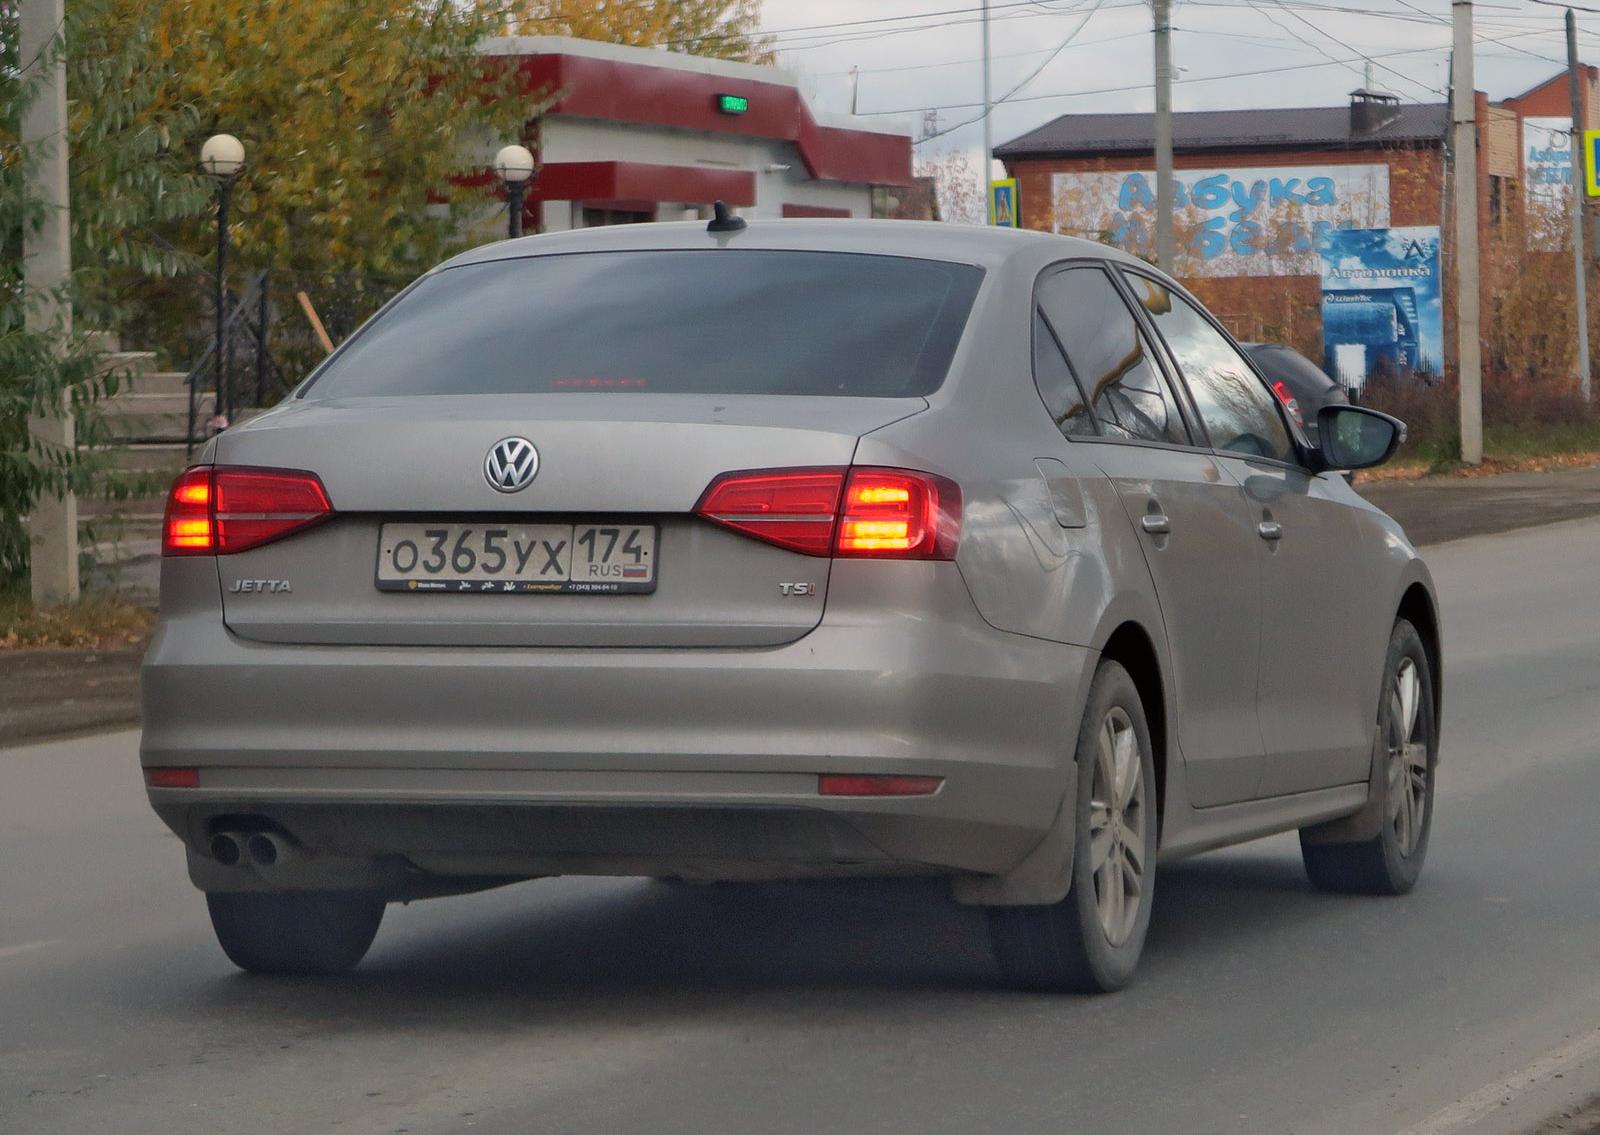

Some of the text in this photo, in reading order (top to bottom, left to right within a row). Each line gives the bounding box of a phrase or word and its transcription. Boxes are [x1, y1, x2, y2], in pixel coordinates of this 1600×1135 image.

[578, 529, 642, 564] 174
[589, 564, 621, 576] RUS
[228, 579, 292, 593] JETTA
